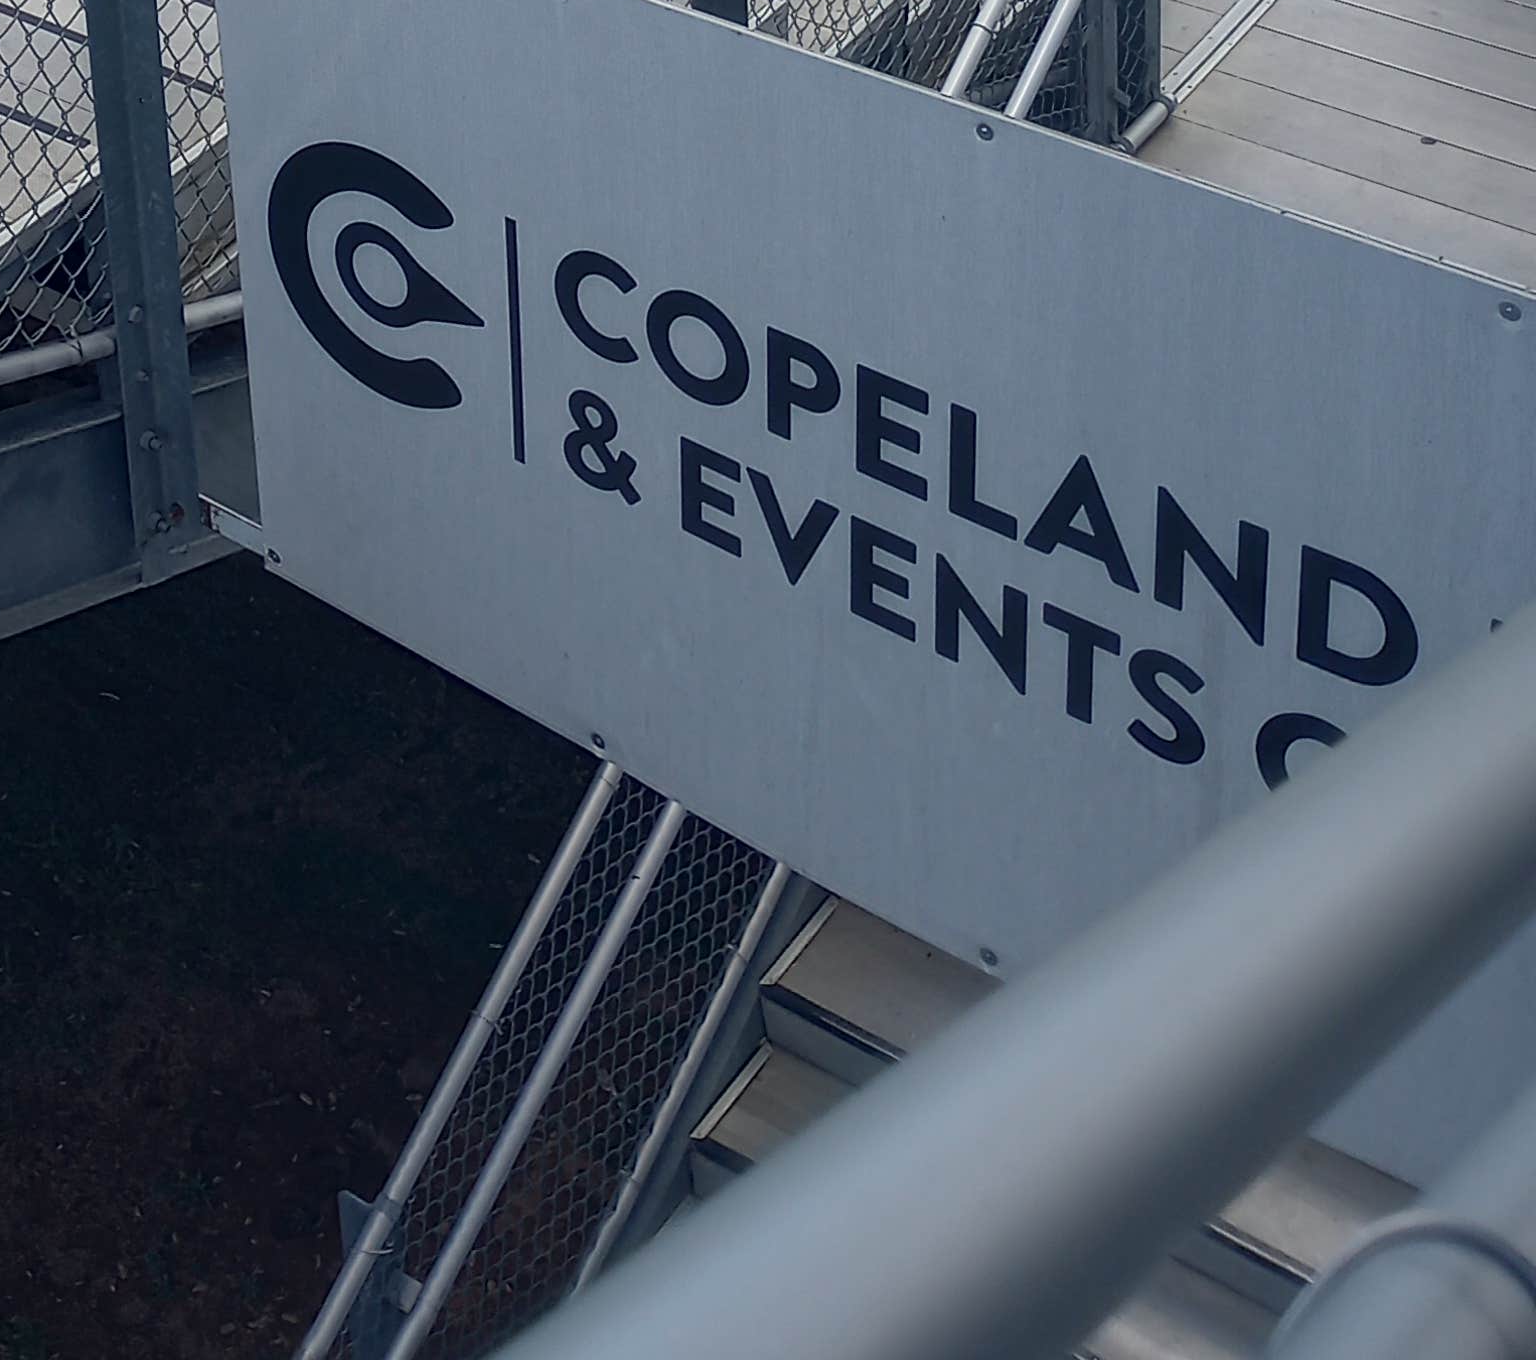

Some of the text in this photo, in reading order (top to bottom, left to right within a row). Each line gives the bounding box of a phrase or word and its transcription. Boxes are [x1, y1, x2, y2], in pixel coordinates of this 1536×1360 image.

[552, 248, 1421, 688] COPELAND
[562, 388, 1207, 767] & EVENTS
